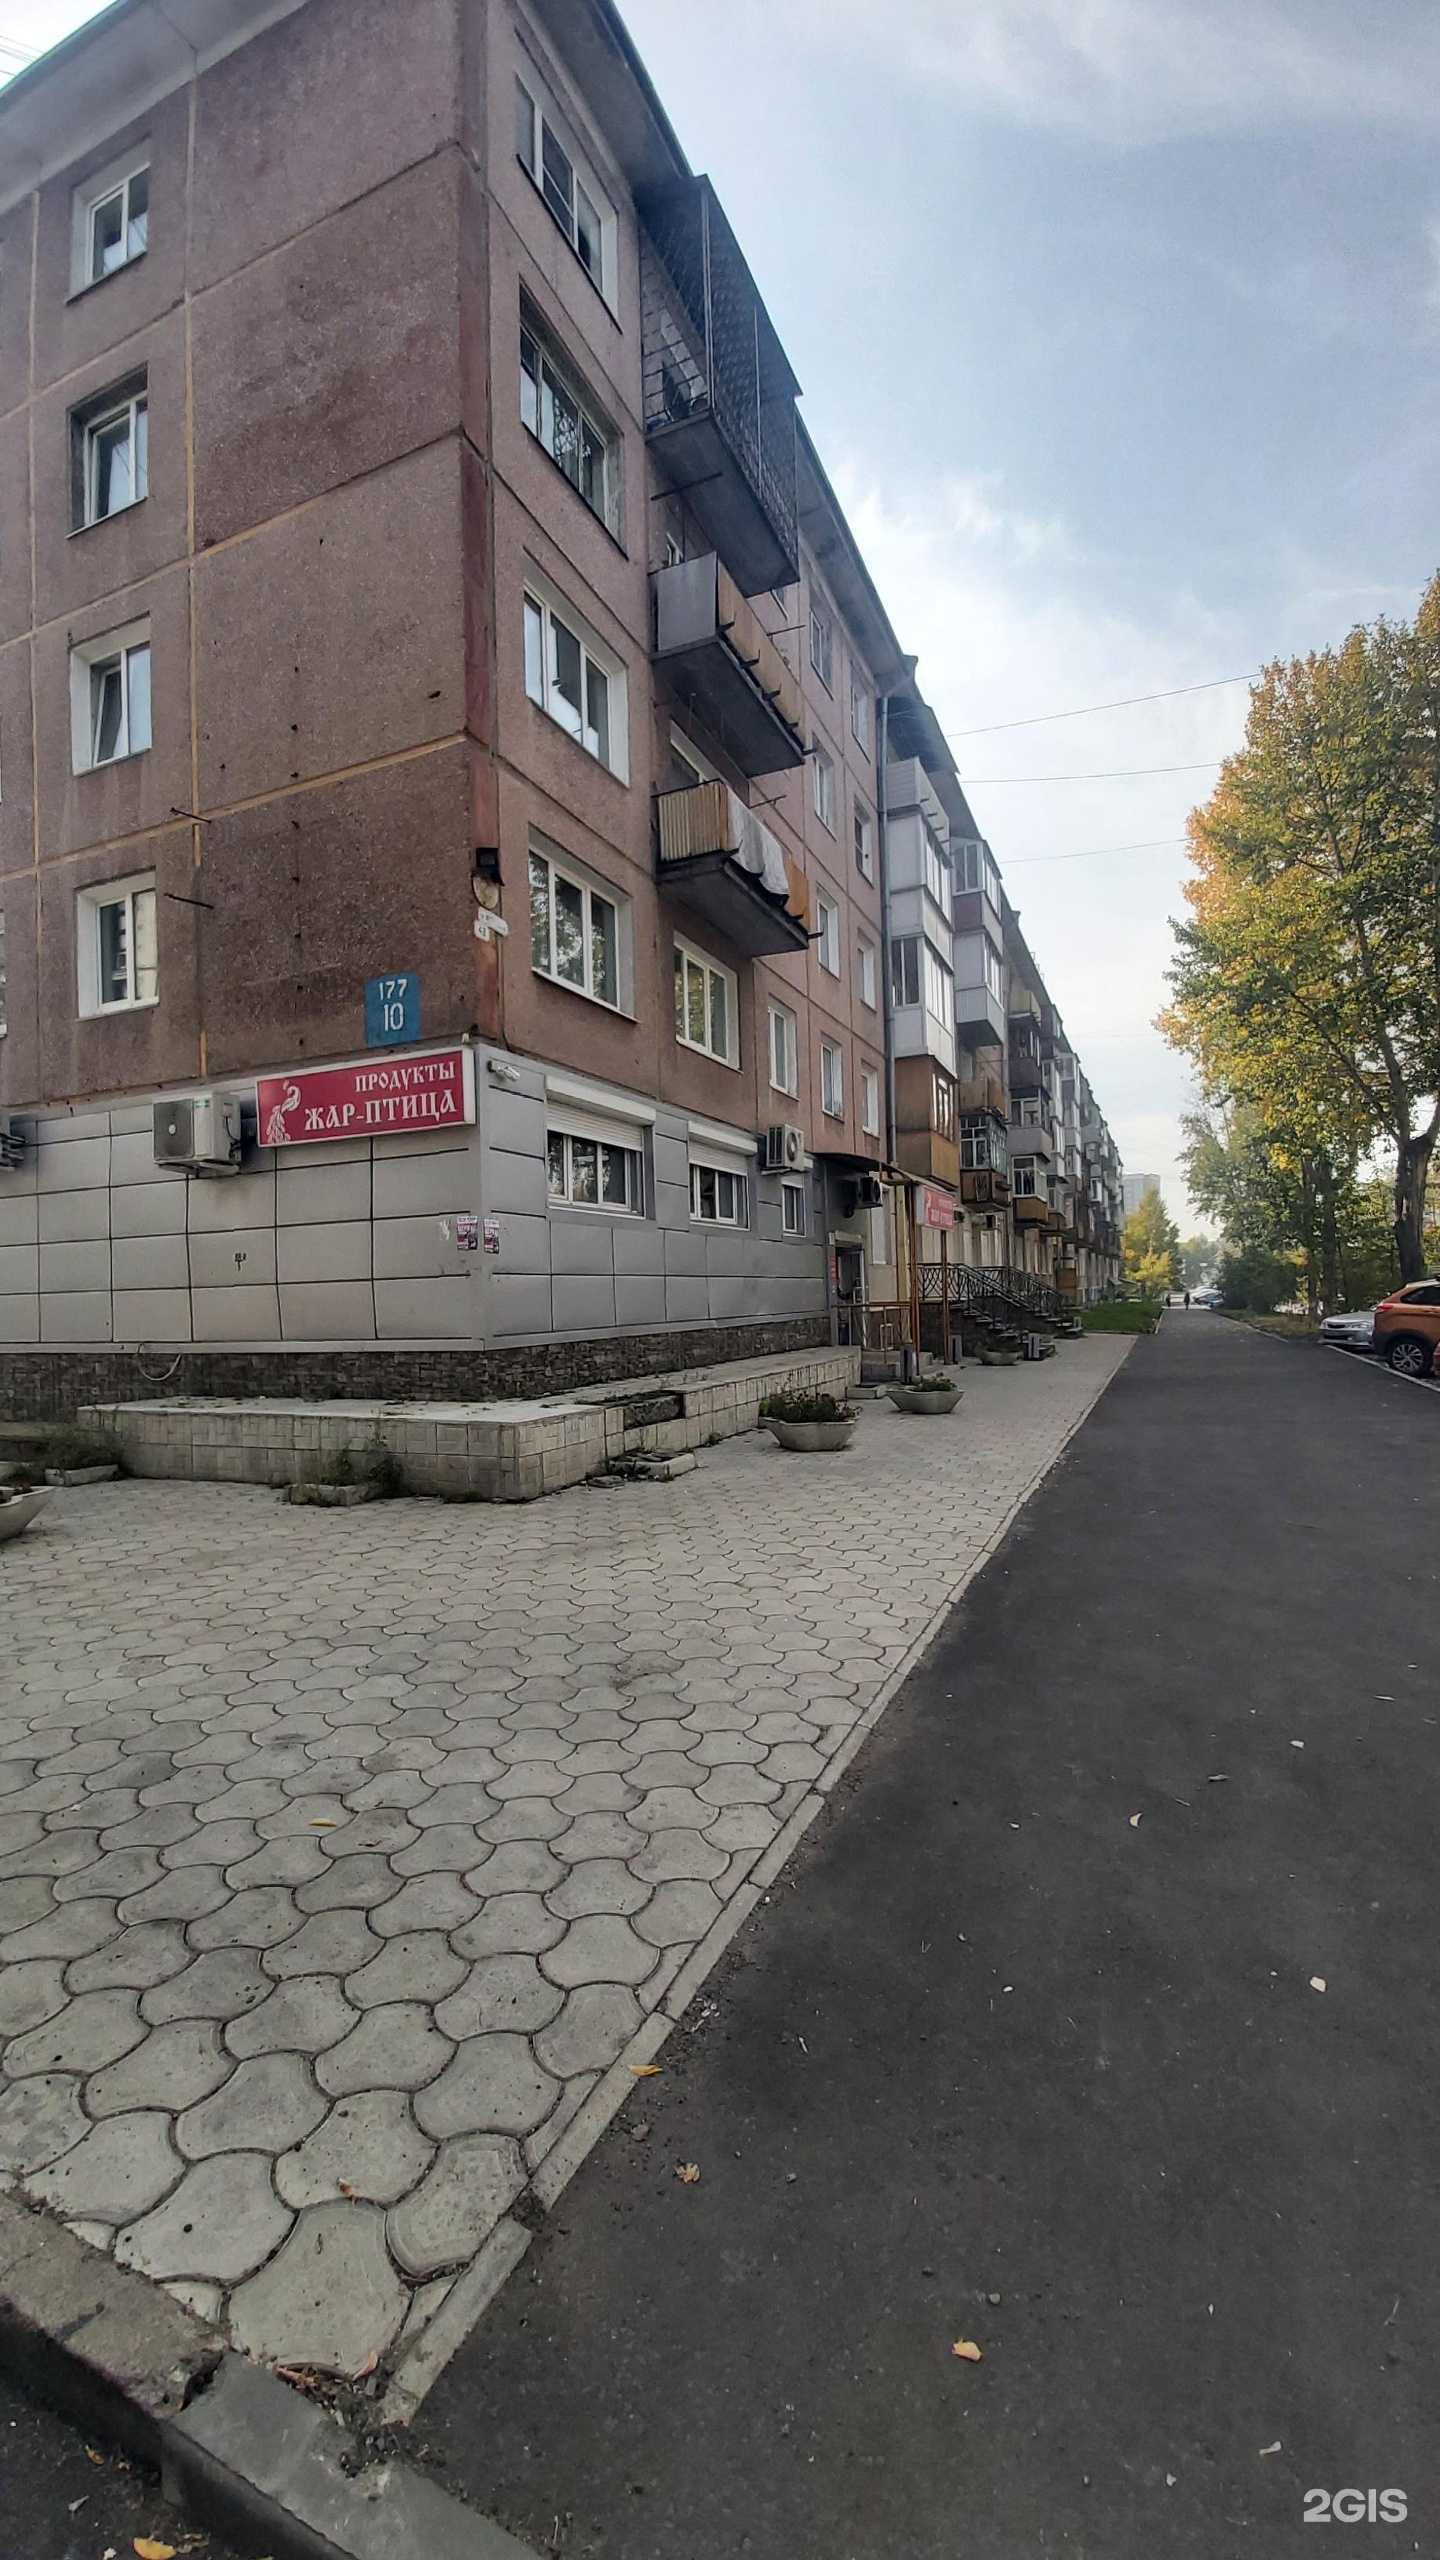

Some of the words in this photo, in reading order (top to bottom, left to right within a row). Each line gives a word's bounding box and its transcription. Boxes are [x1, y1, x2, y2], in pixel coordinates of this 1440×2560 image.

[379, 979, 408, 1000] 177
[384, 1002, 405, 1031] 10
[355, 1061, 455, 1092] ПРОДУКТЫ
[304, 1089, 457, 1130] ЖАР-ПТИЦА
